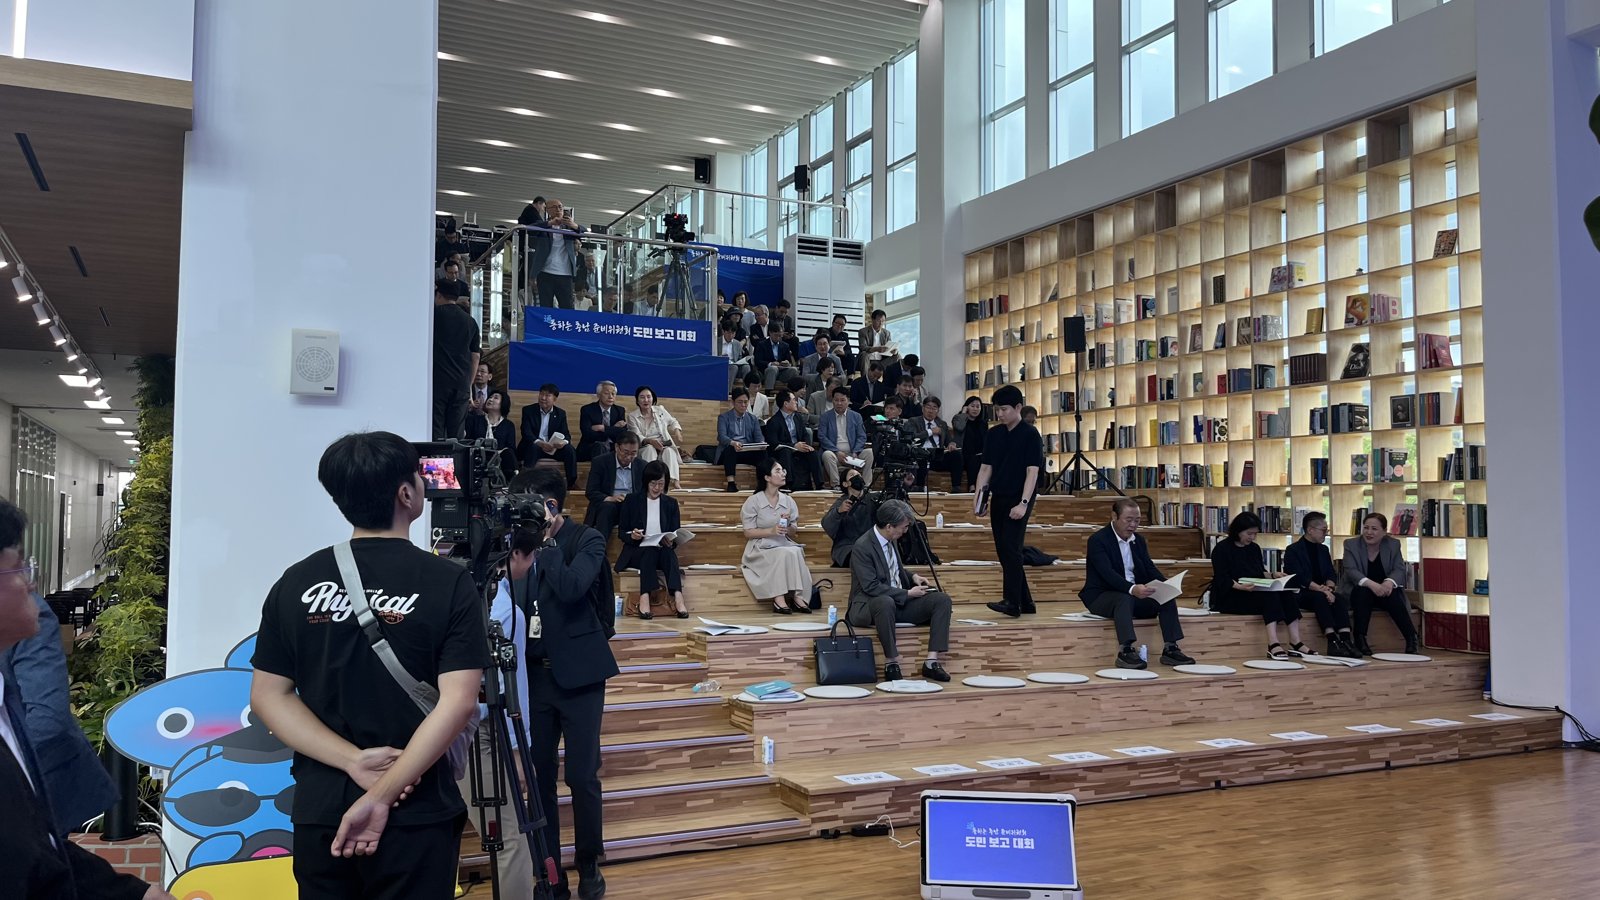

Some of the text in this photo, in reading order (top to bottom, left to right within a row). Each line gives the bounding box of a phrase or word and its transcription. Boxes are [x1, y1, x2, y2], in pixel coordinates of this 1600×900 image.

[741, 255, 753, 264] 도민
[754, 257, 766, 266] 보고
[767, 259, 780, 267] 대회
[575, 320, 590, 333] 충남
[593, 322, 631, 336] 준비위원회
[633, 326, 653, 339] 도민
[655, 327, 675, 340] 보고
[677, 330, 697, 342] 대회
[301, 581, 420, 622] Phyical
[965, 836, 1035, 850] 도민 보고 대회
